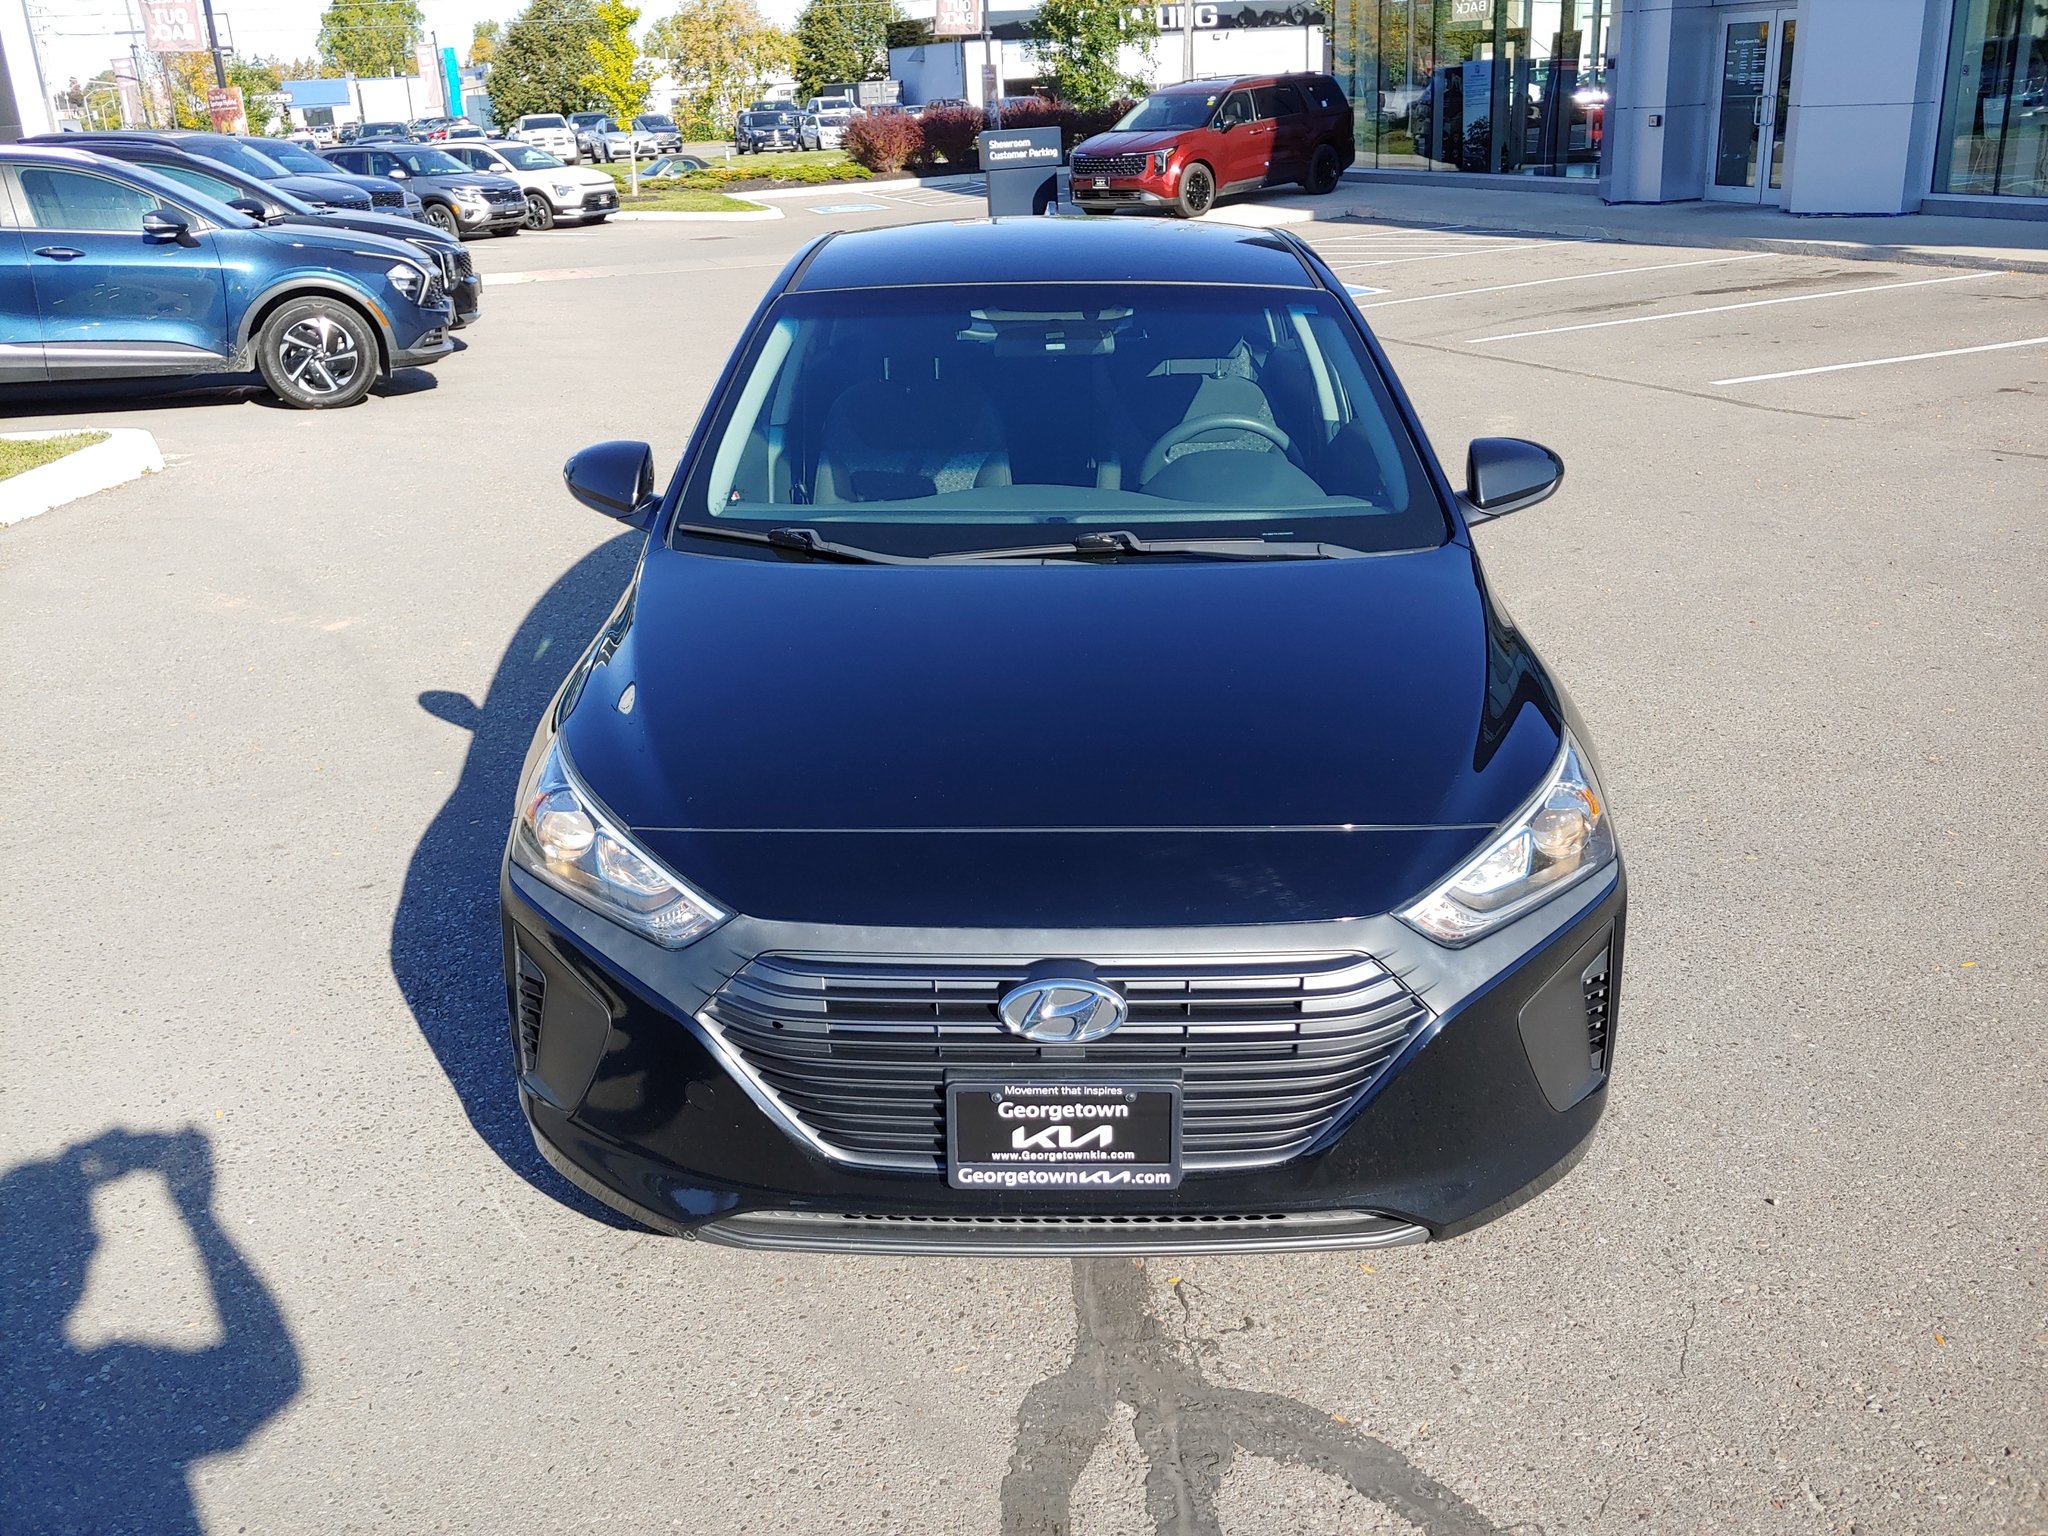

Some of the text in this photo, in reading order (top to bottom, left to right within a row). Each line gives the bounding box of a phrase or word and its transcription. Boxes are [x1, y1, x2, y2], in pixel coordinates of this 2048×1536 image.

[989, 139, 1031, 149] Showroom
[989, 147, 1058, 160] Customer Parking
[1004, 1085, 1123, 1097] Movement that inspires
[998, 1101, 1129, 1121] Georgetown
[1011, 1124, 1113, 1148] KIA
[991, 1150, 1135, 1161] www.Georgetownkia.com
